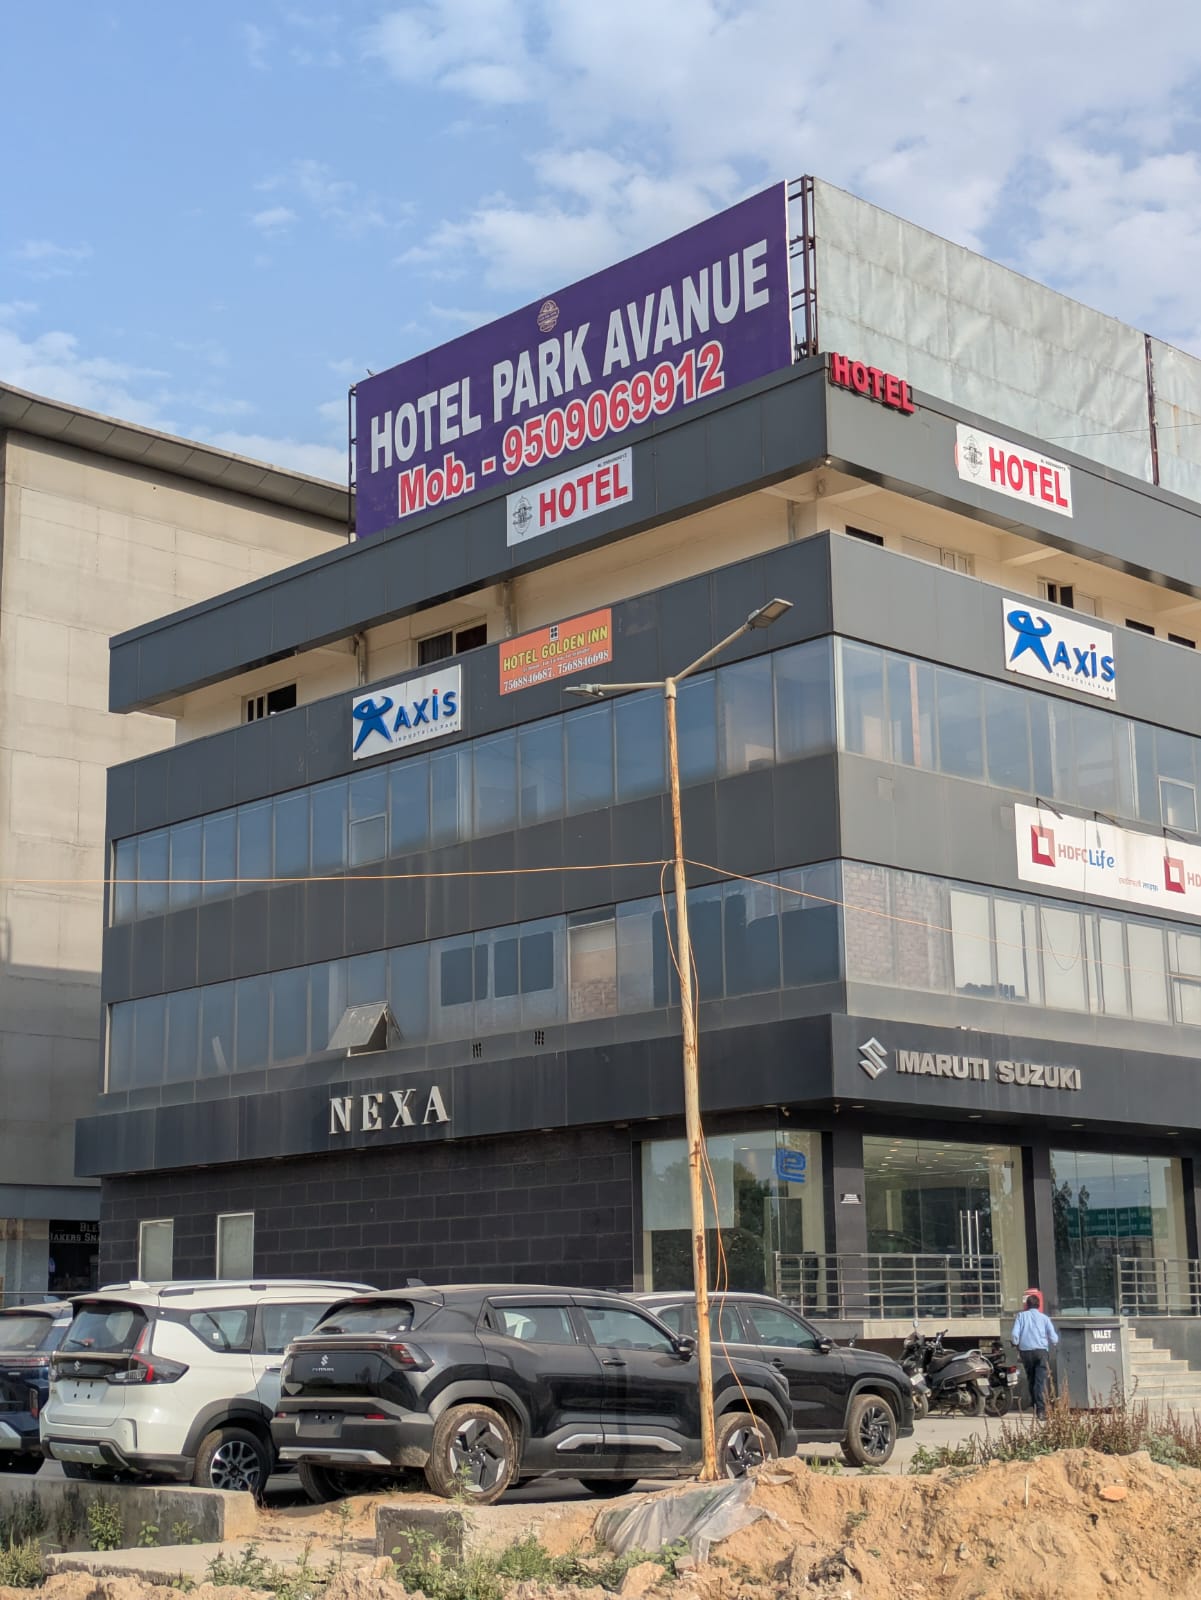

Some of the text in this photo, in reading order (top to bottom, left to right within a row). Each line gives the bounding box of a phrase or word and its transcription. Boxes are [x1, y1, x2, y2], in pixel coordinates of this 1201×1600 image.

[370, 239, 769, 473] HOTEL PARK AVANUE
[503, 340, 725, 475] 9509069912
[831, 352, 914, 414] HOTEL
[539, 463, 628, 527] HOTEL
[988, 446, 1068, 508] HOTEL
[503, 649, 538, 672] HOTEL
[541, 632, 585, 659] GOLDEN
[587, 625, 608, 644] INN
[1187, 871, 1201, 888] HD
[895, 1049, 1082, 1091] MARUTI SUZUKI
[328, 1085, 451, 1134] NEXA
[1091, 1343, 1116, 1352] SERVICE
[1092, 1329, 1112, 1339] VALET
